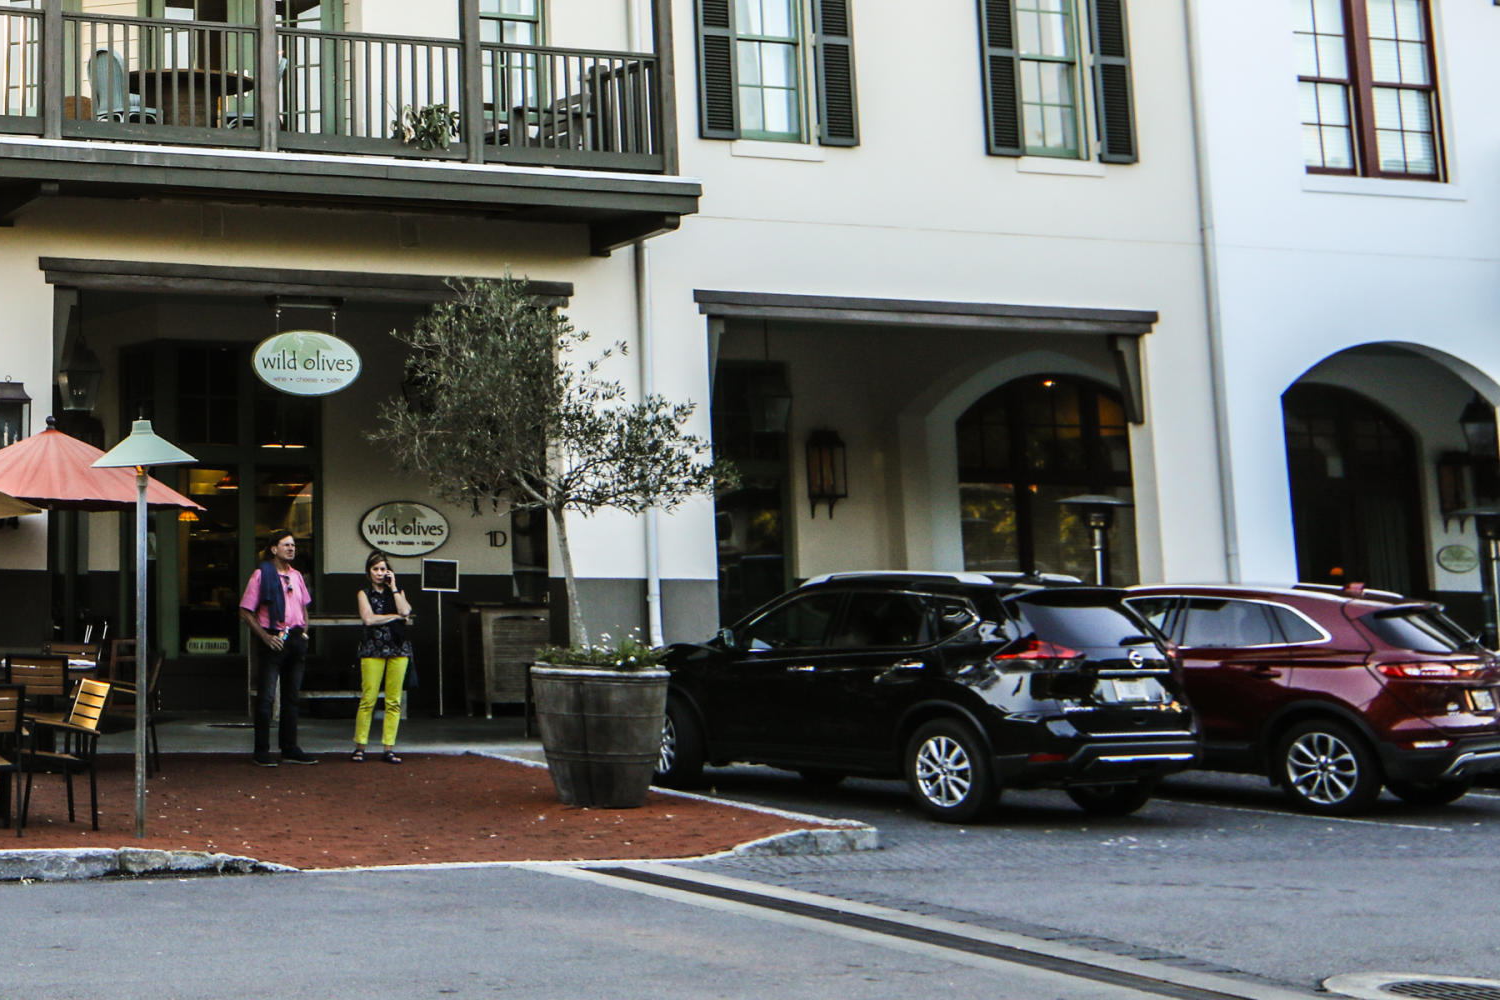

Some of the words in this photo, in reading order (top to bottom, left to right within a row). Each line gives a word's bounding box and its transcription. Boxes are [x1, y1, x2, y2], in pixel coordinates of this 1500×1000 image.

[262, 349, 297, 371] wild
[303, 349, 354, 372] olives
[368, 517, 398, 536] wild
[402, 517, 444, 536] olives
[485, 530, 507, 547] 1D
